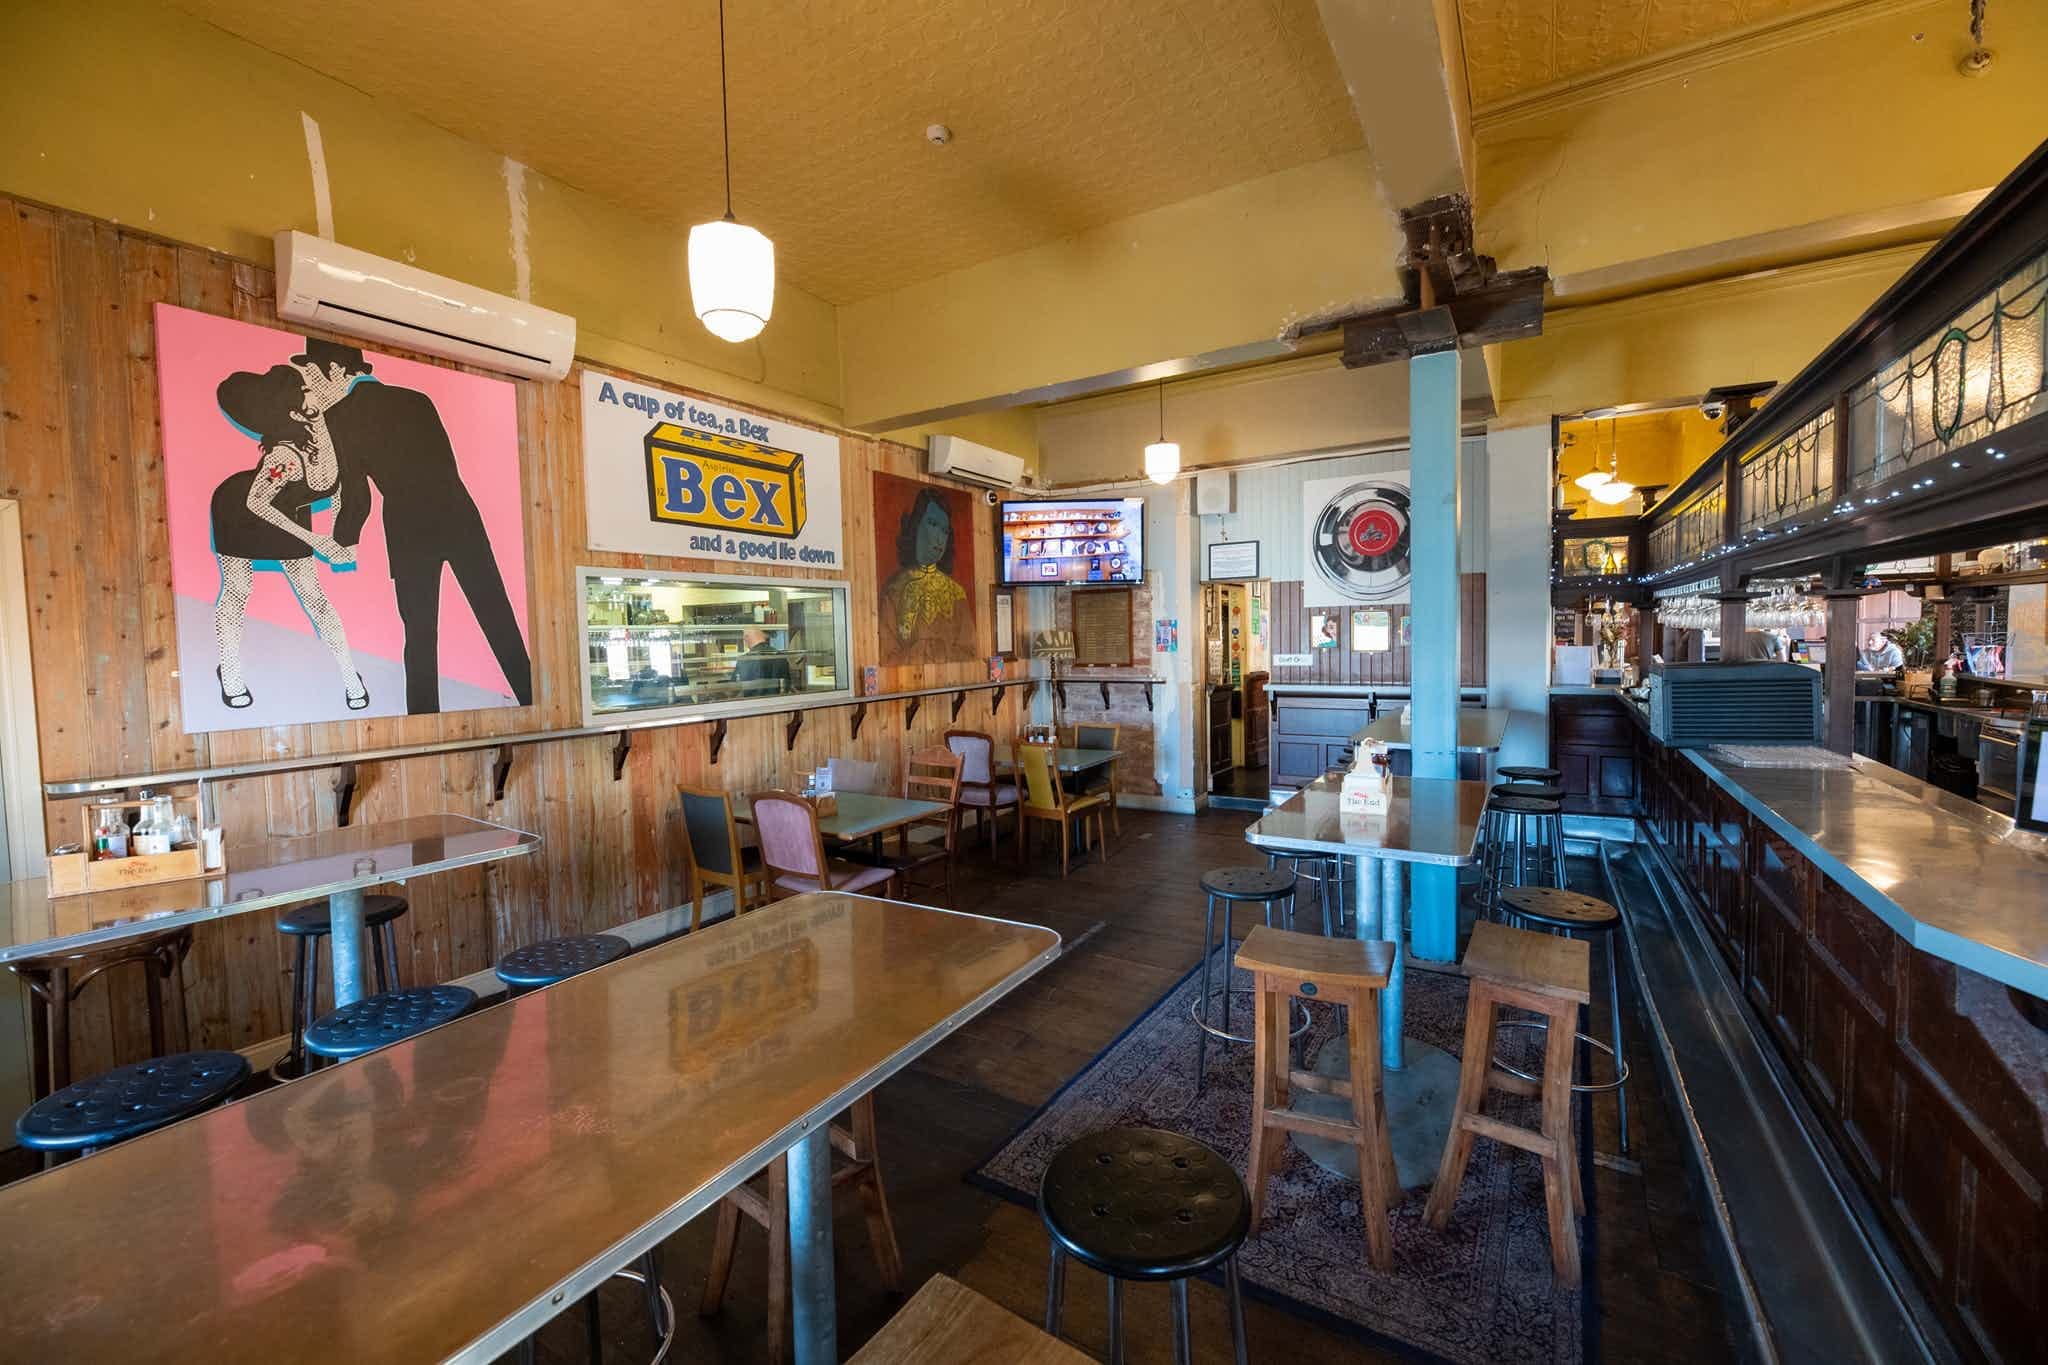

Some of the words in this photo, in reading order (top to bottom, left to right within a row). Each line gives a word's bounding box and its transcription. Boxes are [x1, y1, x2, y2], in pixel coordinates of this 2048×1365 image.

[599, 382, 619, 405] A
[622, 392, 660, 419] cup
[664, 401, 685, 420] of
[689, 406, 722, 433] tea,
[726, 418, 737, 434] a
[740, 418, 769, 443] Bex
[661, 456, 785, 526] Bex
[690, 534, 721, 552] and
[726, 539, 736, 554] a
[739, 541, 776, 560] good
[780, 543, 796, 560] lie
[800, 546, 835, 564] down
